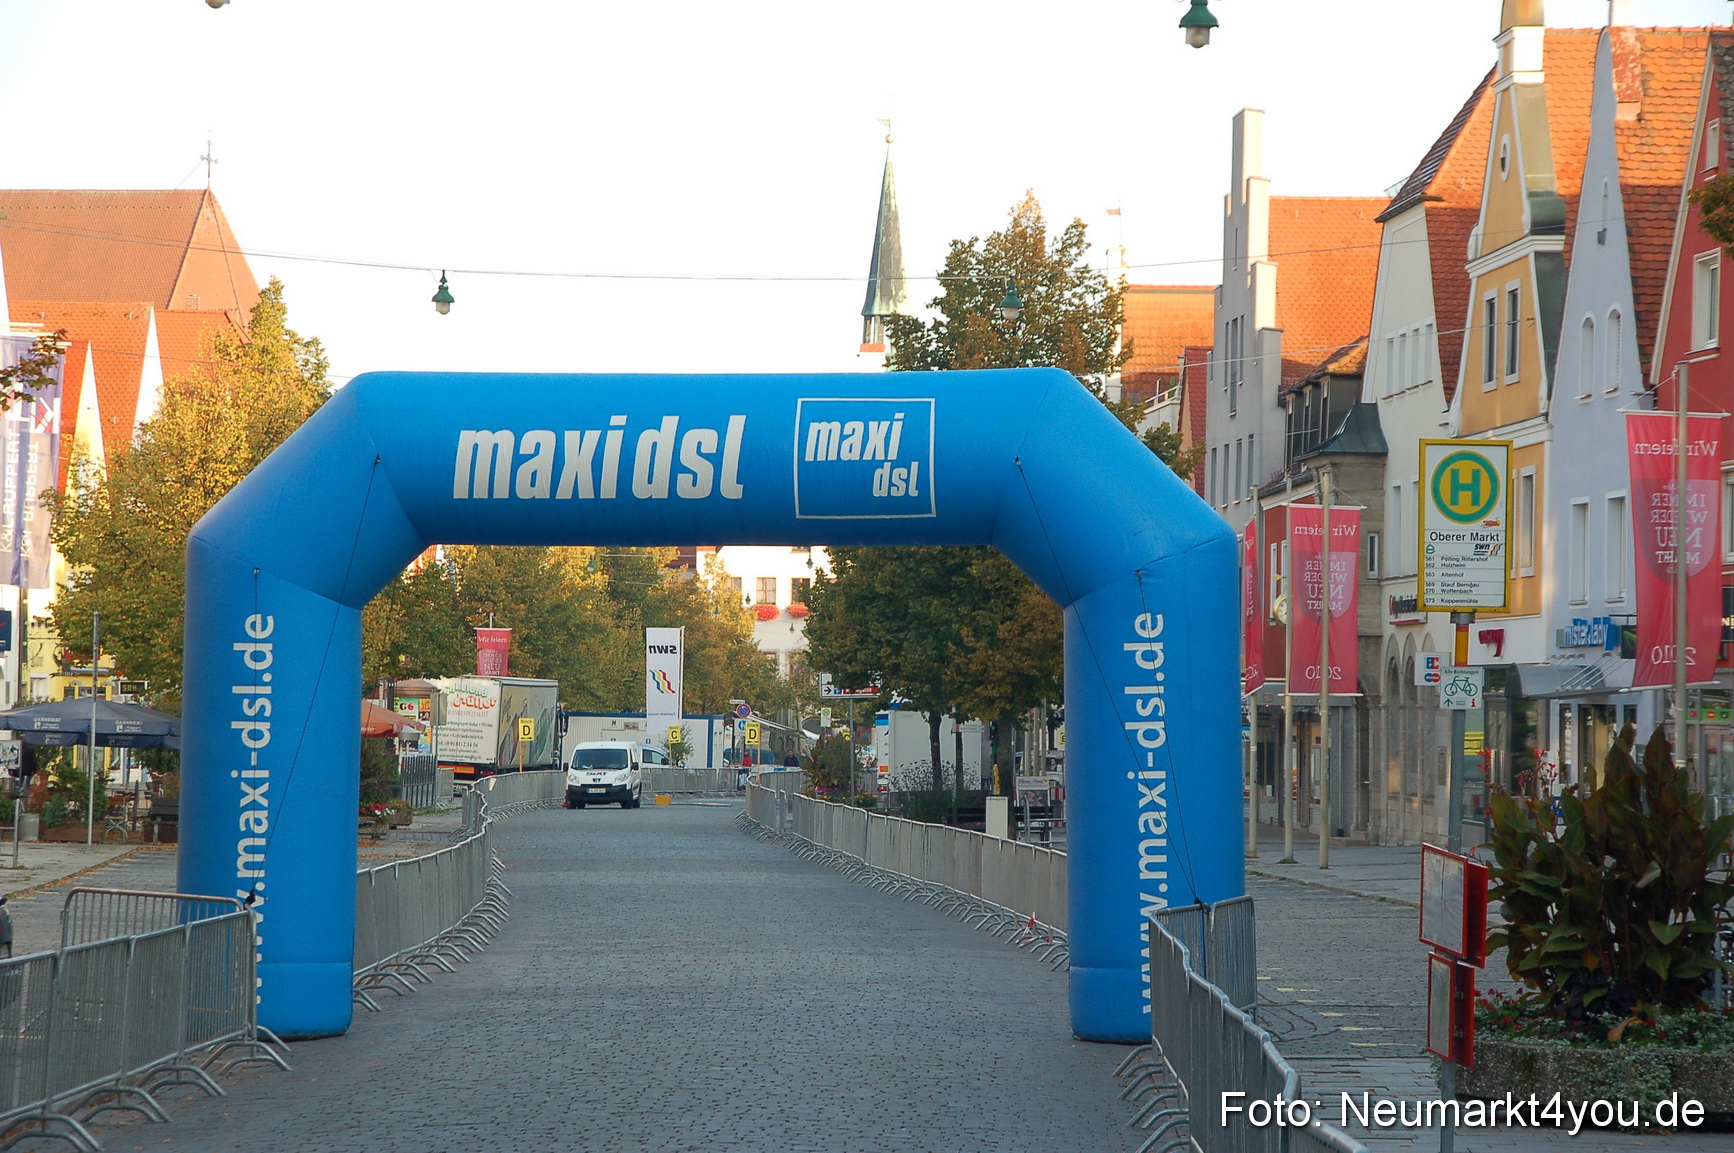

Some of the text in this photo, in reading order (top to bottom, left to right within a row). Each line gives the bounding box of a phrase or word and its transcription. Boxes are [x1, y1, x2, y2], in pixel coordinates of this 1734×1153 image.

[805, 412, 905, 462] maxi
[453, 415, 747, 499] maxi dsl
[872, 461, 919, 497] dsl
[1450, 468, 1481, 507] H
[1430, 531, 1500, 542] Oberer Markt
[479, 635, 489, 643] Wir
[522, 725, 530, 735] D
[671, 730, 678, 739] C
[749, 728, 757, 739] D
